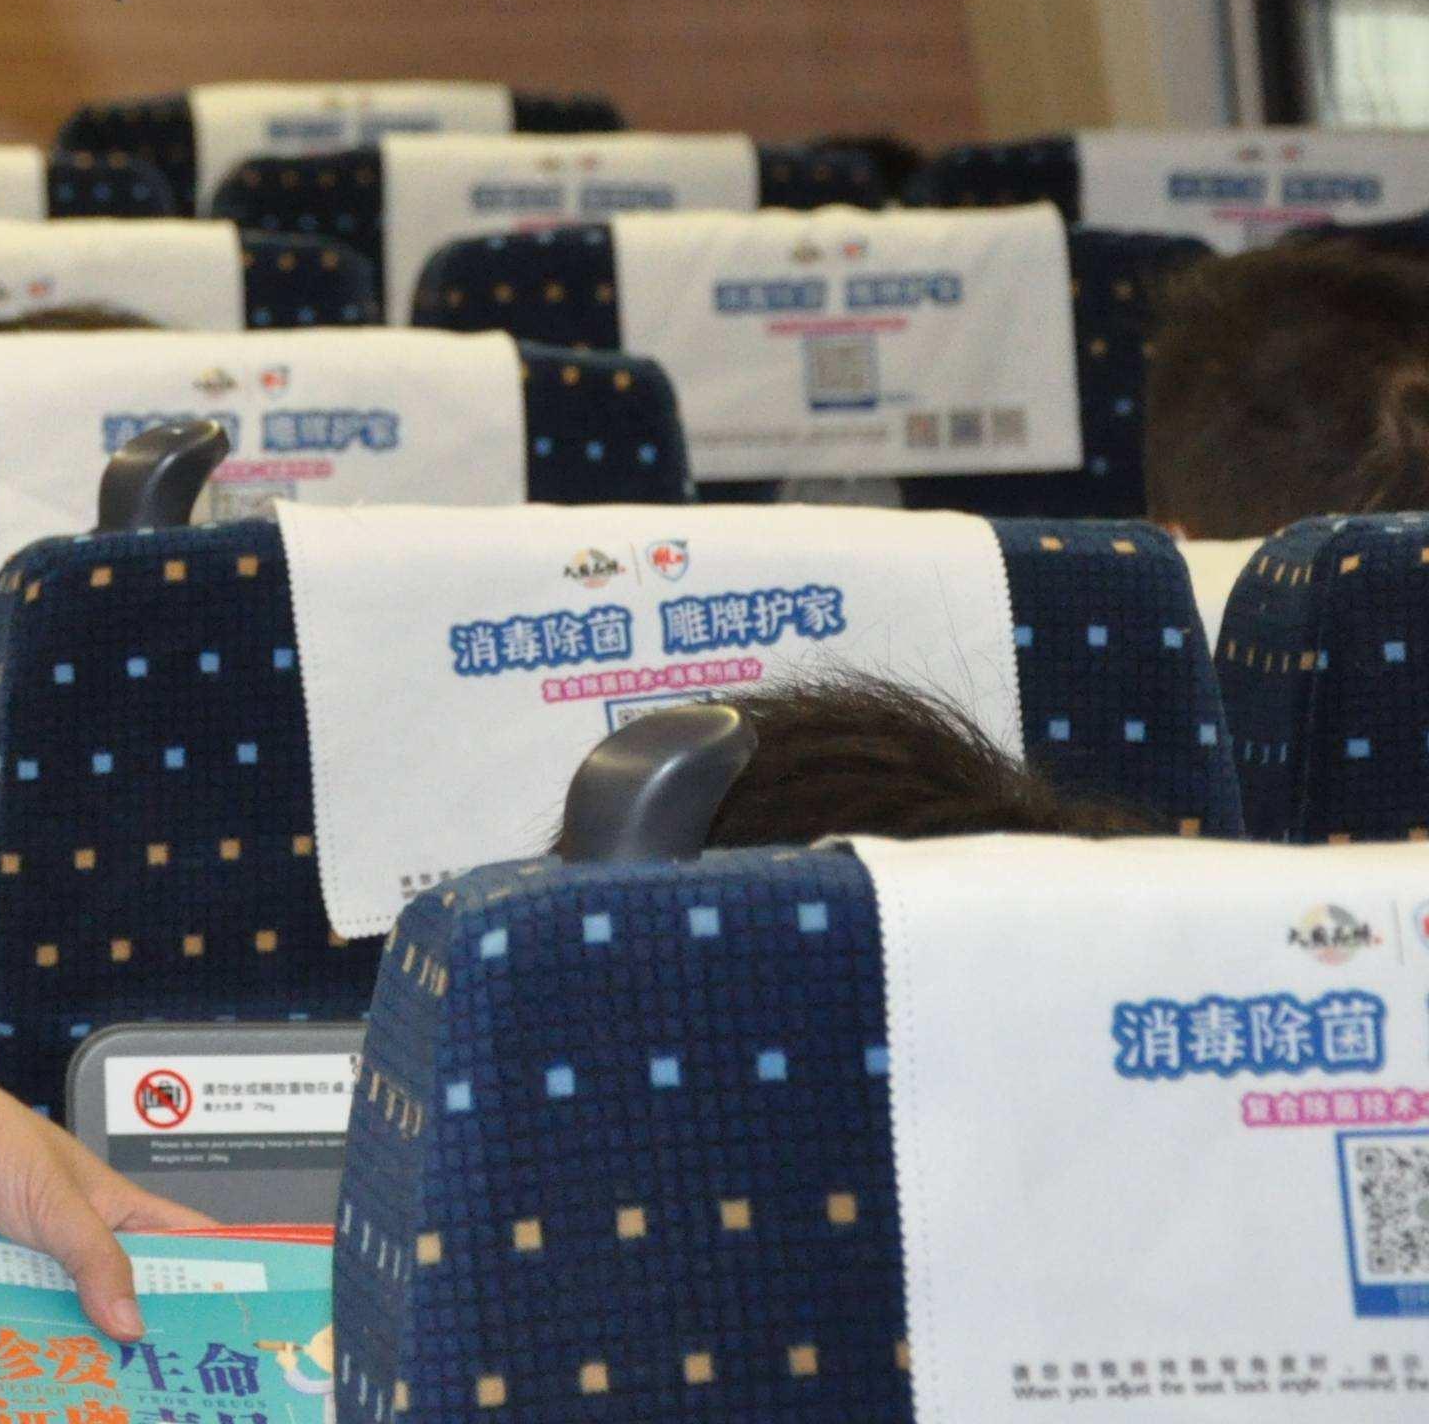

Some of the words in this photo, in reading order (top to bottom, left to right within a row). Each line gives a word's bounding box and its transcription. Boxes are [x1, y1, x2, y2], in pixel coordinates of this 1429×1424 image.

[453, 606, 631, 673] 消毒除菌
[662, 585, 844, 654] 雕牌护家
[1119, 993, 1383, 1075] 消毒除菌
